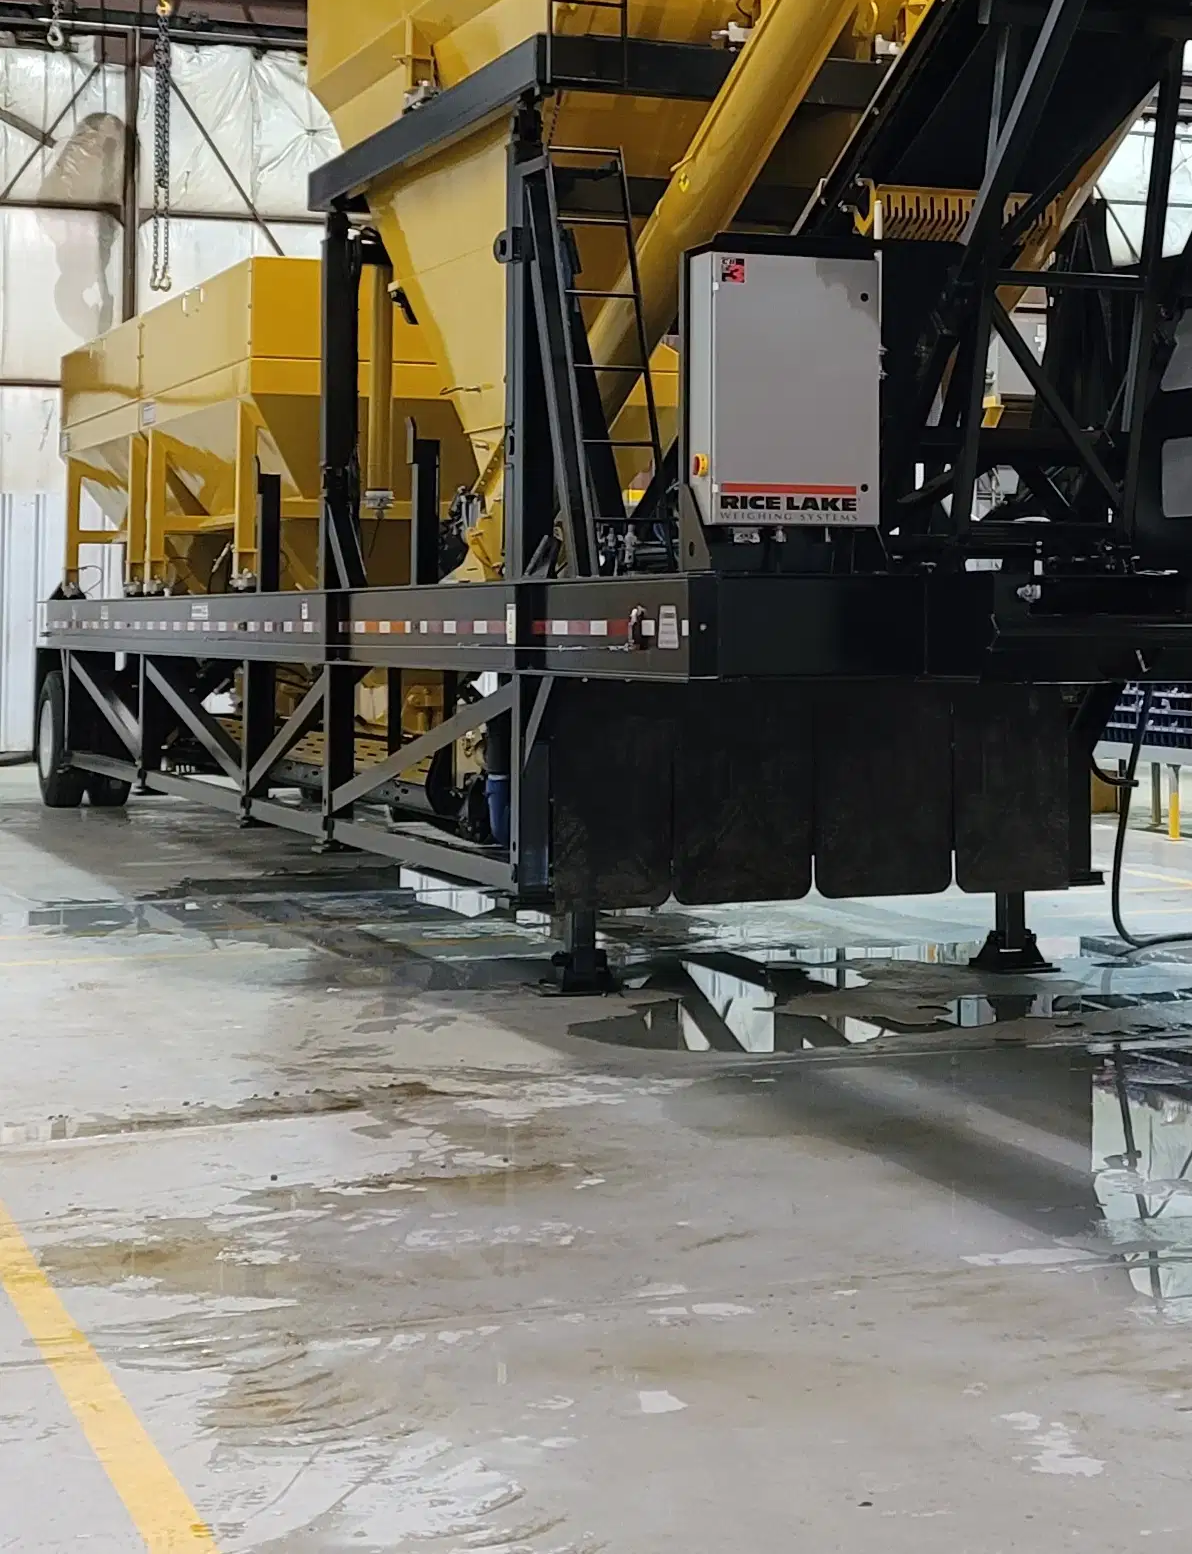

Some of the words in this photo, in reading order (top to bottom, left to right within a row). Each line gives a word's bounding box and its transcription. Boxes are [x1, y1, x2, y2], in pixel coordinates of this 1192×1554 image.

[720, 495, 781, 510] RICE
[786, 497, 857, 511] LAKE
[720, 511, 793, 521] WEIGHING
[799, 512, 858, 523] SYSTEMS
